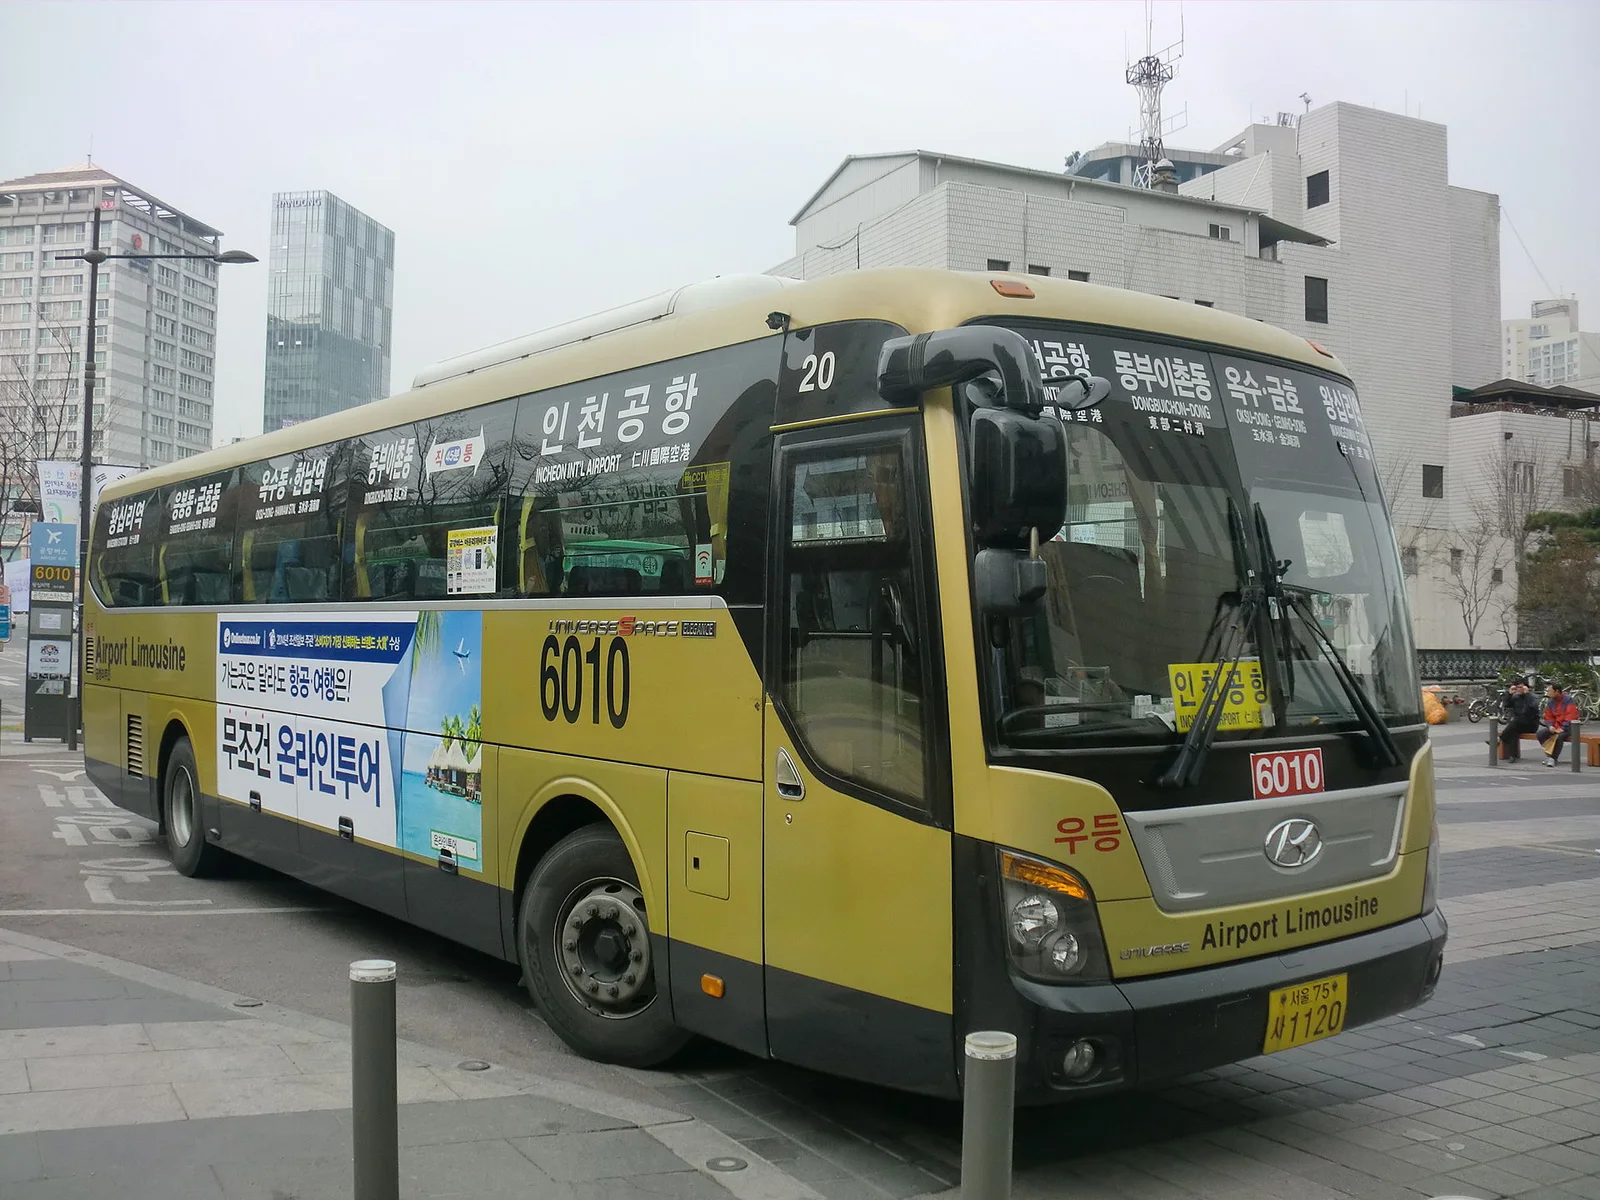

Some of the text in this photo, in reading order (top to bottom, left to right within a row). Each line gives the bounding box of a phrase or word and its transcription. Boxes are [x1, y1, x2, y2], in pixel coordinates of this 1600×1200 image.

[799, 351, 836, 393] 20
[1113, 350, 1212, 402] 동부이촌동
[540, 372, 699, 456] 인천공항
[368, 438, 415, 485] 동부이촌동
[535, 463, 567, 484] INCHEON
[586, 453, 622, 476] AIRPORT
[631, 442, 691, 469] 仁川國際空港
[108, 500, 146, 535] 왕십리역
[40, 547, 68, 555] 공항버스
[35, 566, 71, 581] 6010
[682, 621, 714, 636] ELEGANCE
[95, 635, 186, 672] Airport Limousine
[221, 660, 255, 692] 가는곳은
[258, 663, 286, 694] 달라도
[540, 634, 630, 729] 6010
[222, 717, 381, 808] 무조건 온라인투어
[1255, 754, 1320, 795] 6010
[1054, 813, 1121, 855] 우등
[1201, 895, 1380, 950] Airport Limousine
[1120, 941, 1191, 961] UNIVERSE
[1291, 982, 1330, 1006] 서울 75
[1270, 1000, 1342, 1042] 사 1120
